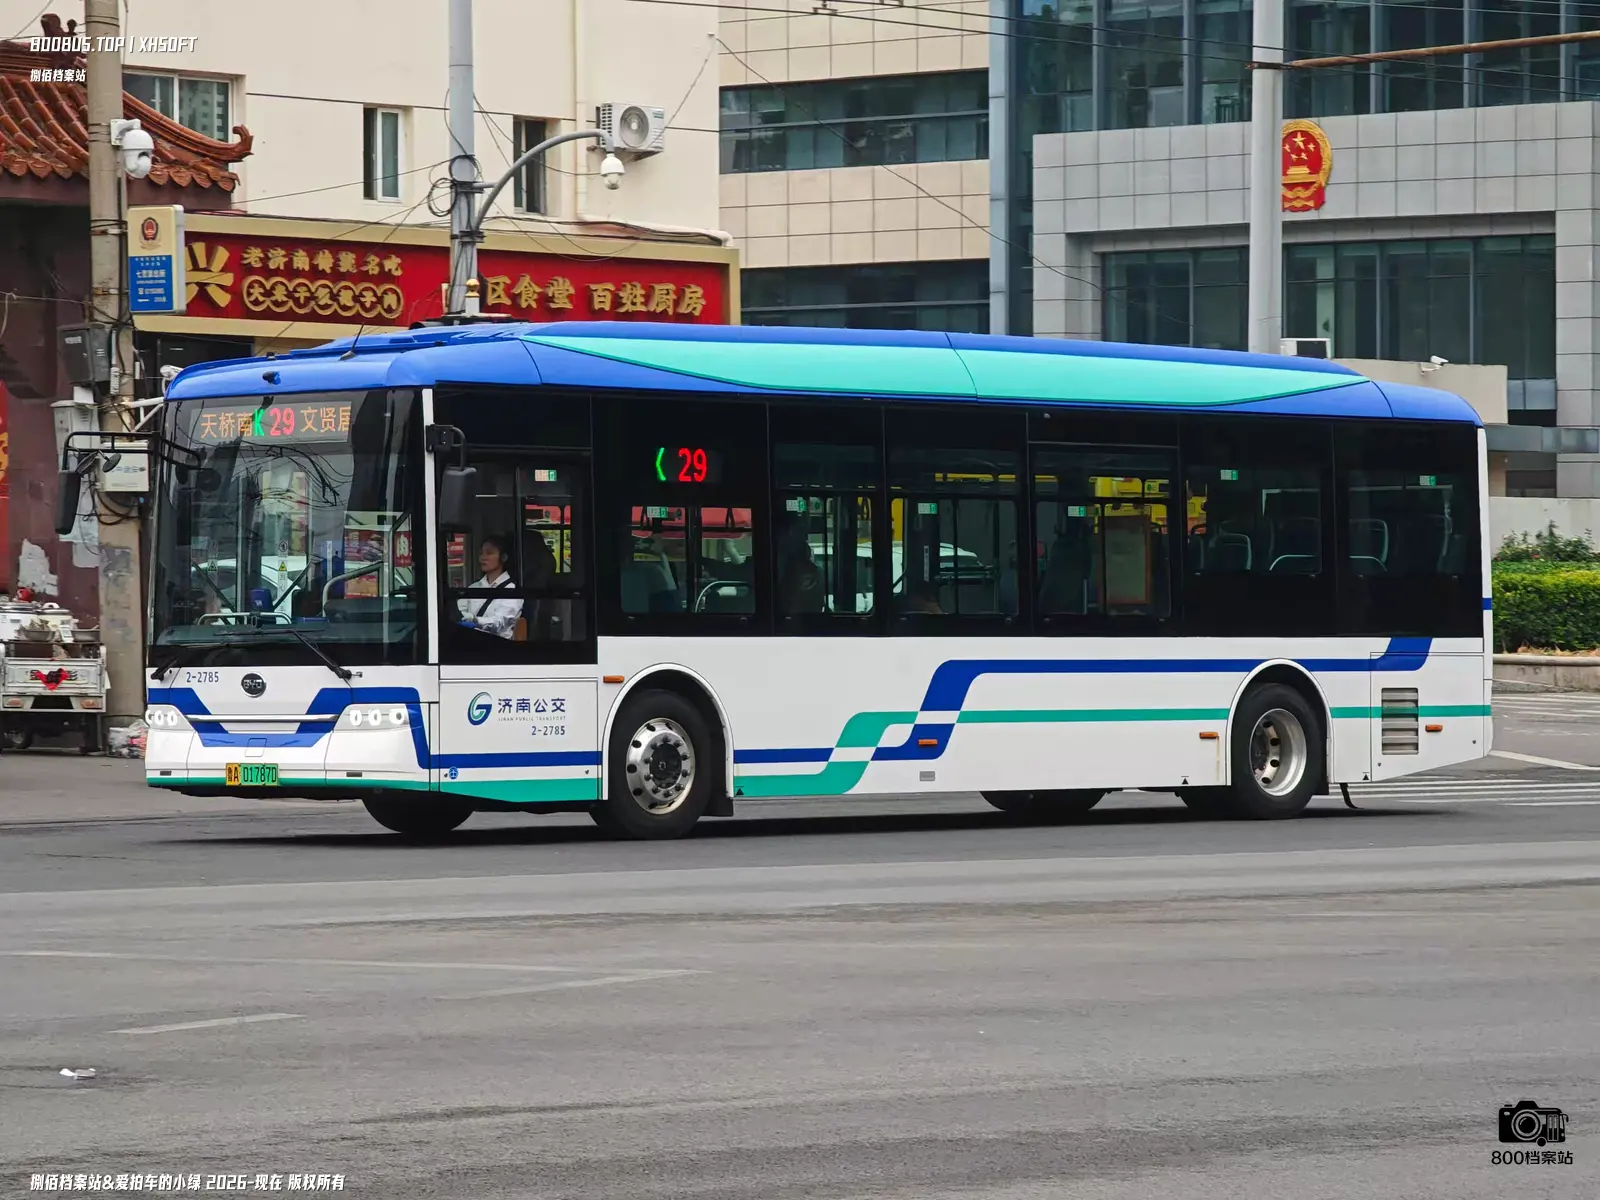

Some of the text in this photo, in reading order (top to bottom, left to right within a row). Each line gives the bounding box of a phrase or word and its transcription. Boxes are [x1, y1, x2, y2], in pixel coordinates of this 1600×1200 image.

[485, 273, 706, 317] 区食堂 百姓厨房
[200, 411, 254, 439] 天桥南
[186, 671, 219, 683] 2-2785
[497, 698, 567, 714] 济南公交
[531, 725, 566, 736] 2-2785
